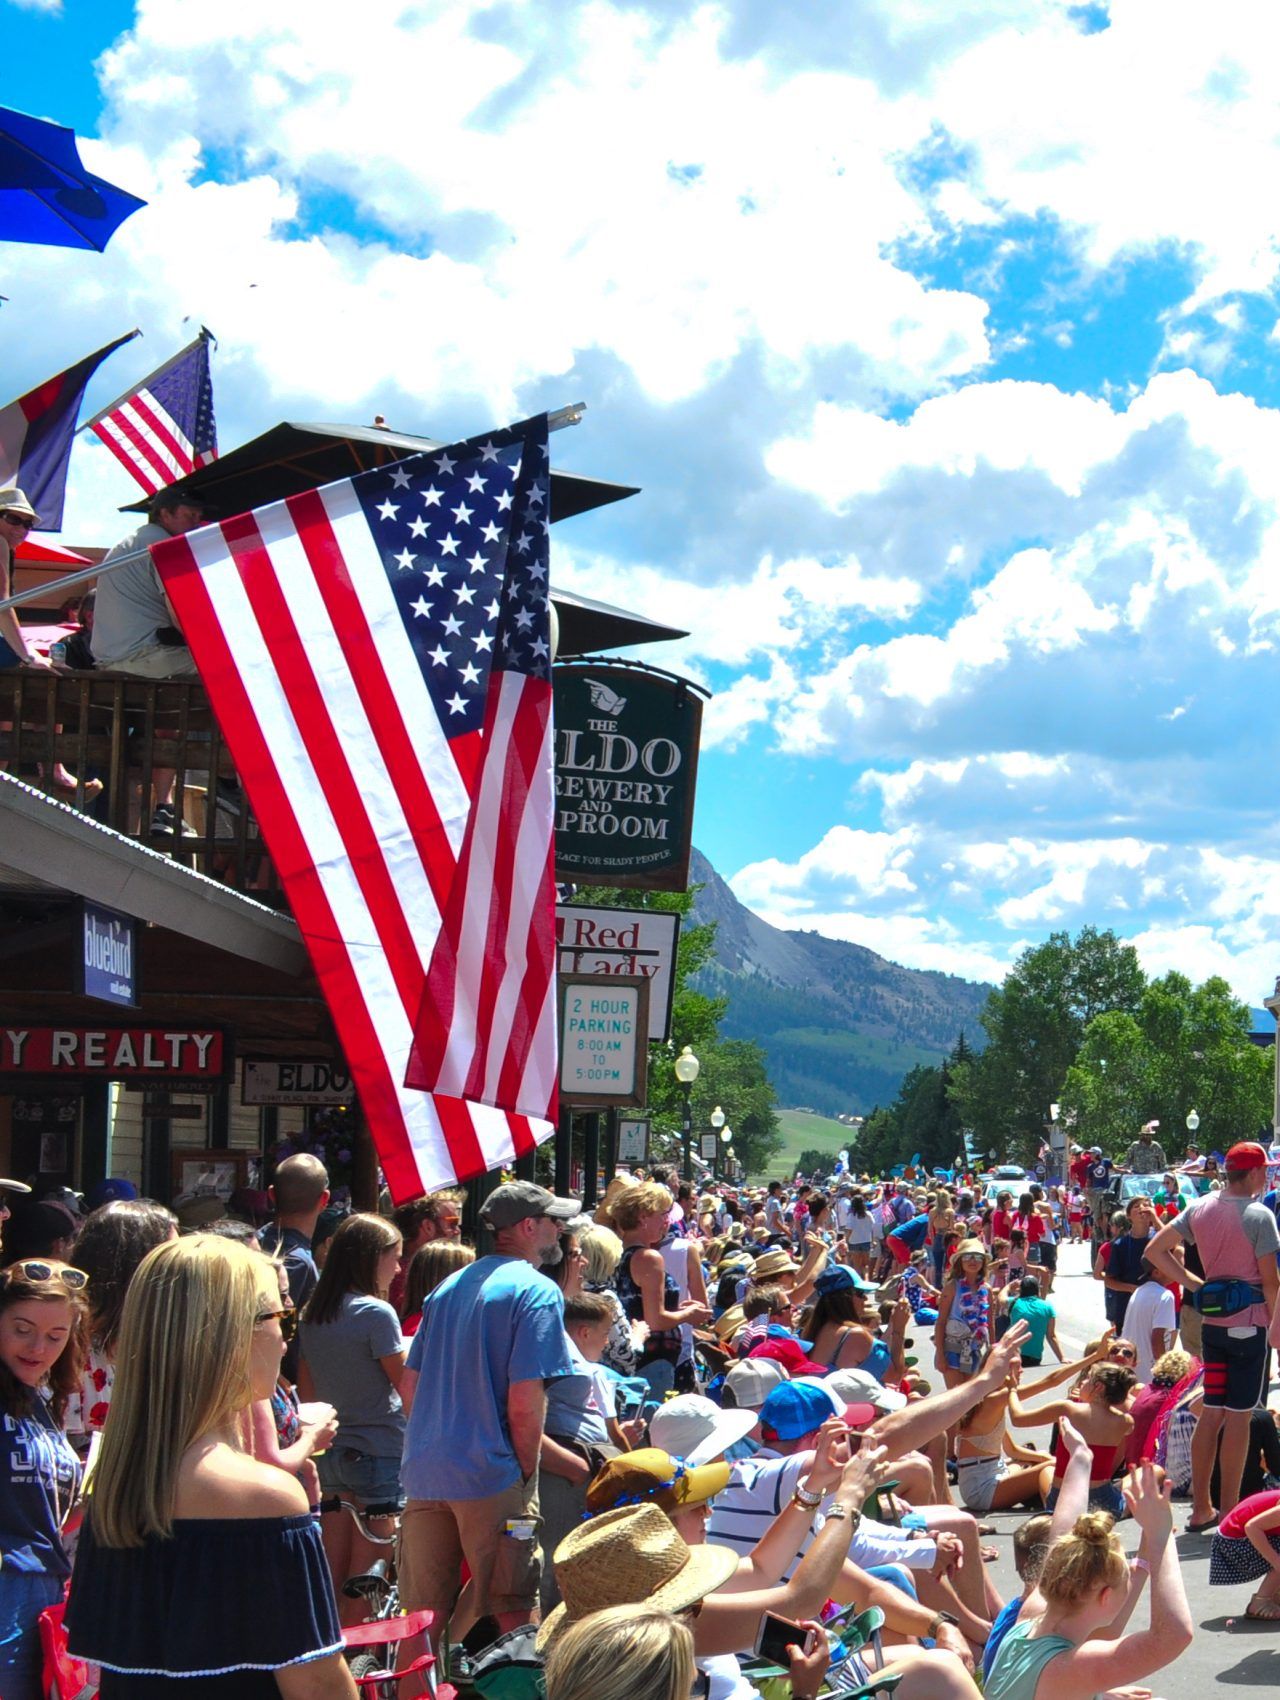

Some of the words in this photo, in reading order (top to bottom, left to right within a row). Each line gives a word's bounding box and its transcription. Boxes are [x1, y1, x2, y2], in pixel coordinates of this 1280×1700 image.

[587, 718, 618, 732] THE
[554, 774, 674, 806] REWERY
[578, 800, 612, 813] AND
[554, 810, 670, 840] PROOM
[583, 855, 602, 865] FOR
[603, 856, 634, 866] SHADY
[636, 849, 671, 864] PEOPLE
[573, 918, 640, 949] Red
[84, 912, 131, 979] bluebird
[573, 998, 582, 1013] 2
[591, 1000, 629, 1015] HOUR
[569, 1019, 631, 1034] PARKING
[52, 1031, 214, 1068] REALTY
[593, 1054, 605, 1064] TO
[277, 1064, 348, 1092] ELDO
